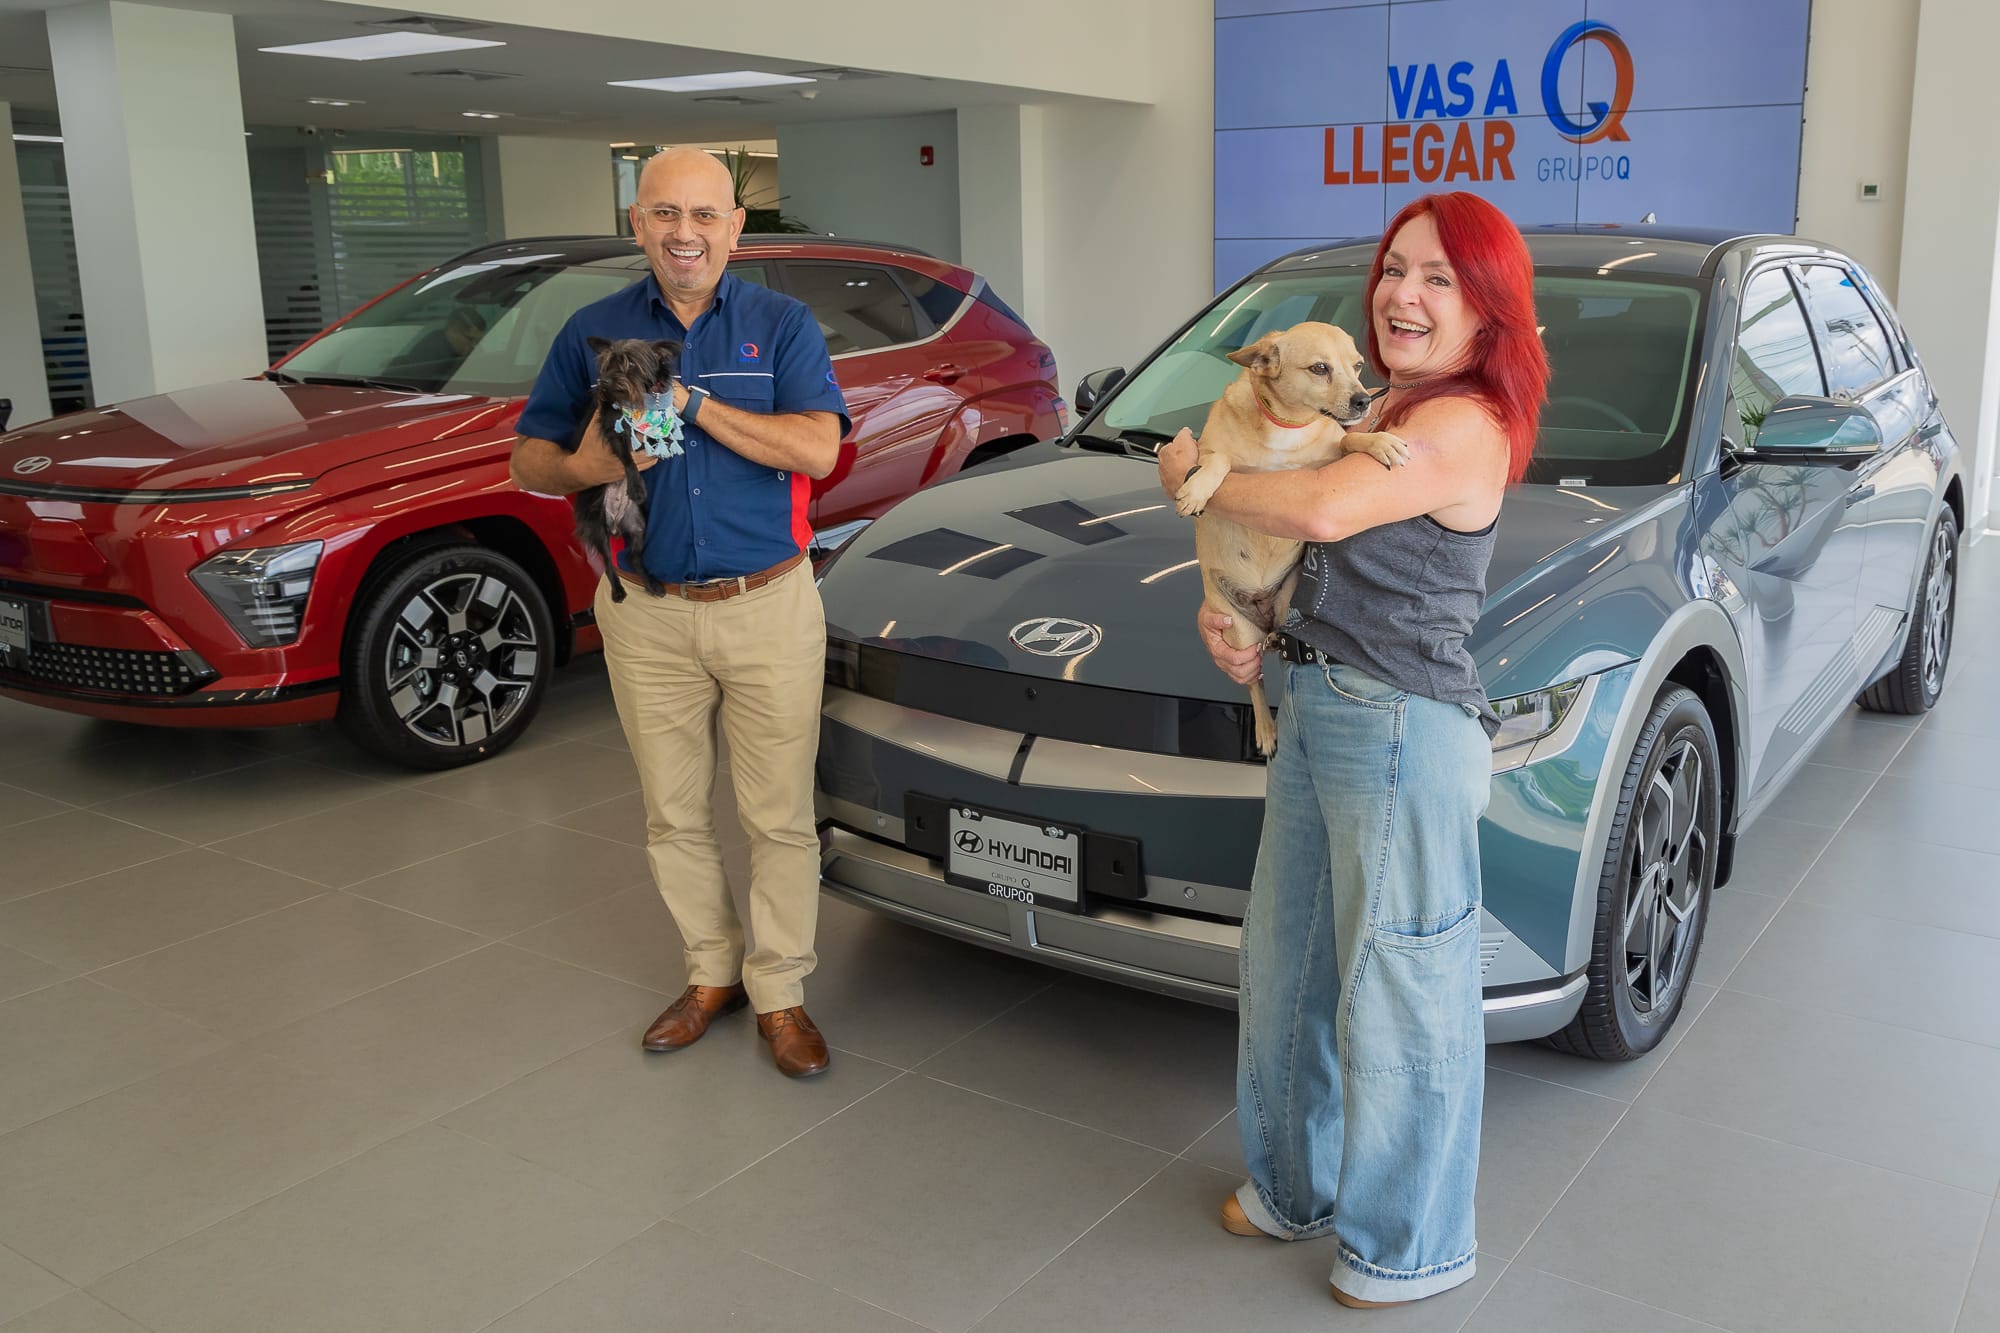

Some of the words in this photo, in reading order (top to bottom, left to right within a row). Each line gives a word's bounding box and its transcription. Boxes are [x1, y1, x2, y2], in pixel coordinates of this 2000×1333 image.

[1388, 61, 1474, 120] VAS
[1484, 58, 1518, 116] A
[1323, 119, 1516, 185] LLEGAR
[988, 838, 1072, 875] HYUNDAI
[988, 883, 1034, 905] GRUPOQ
